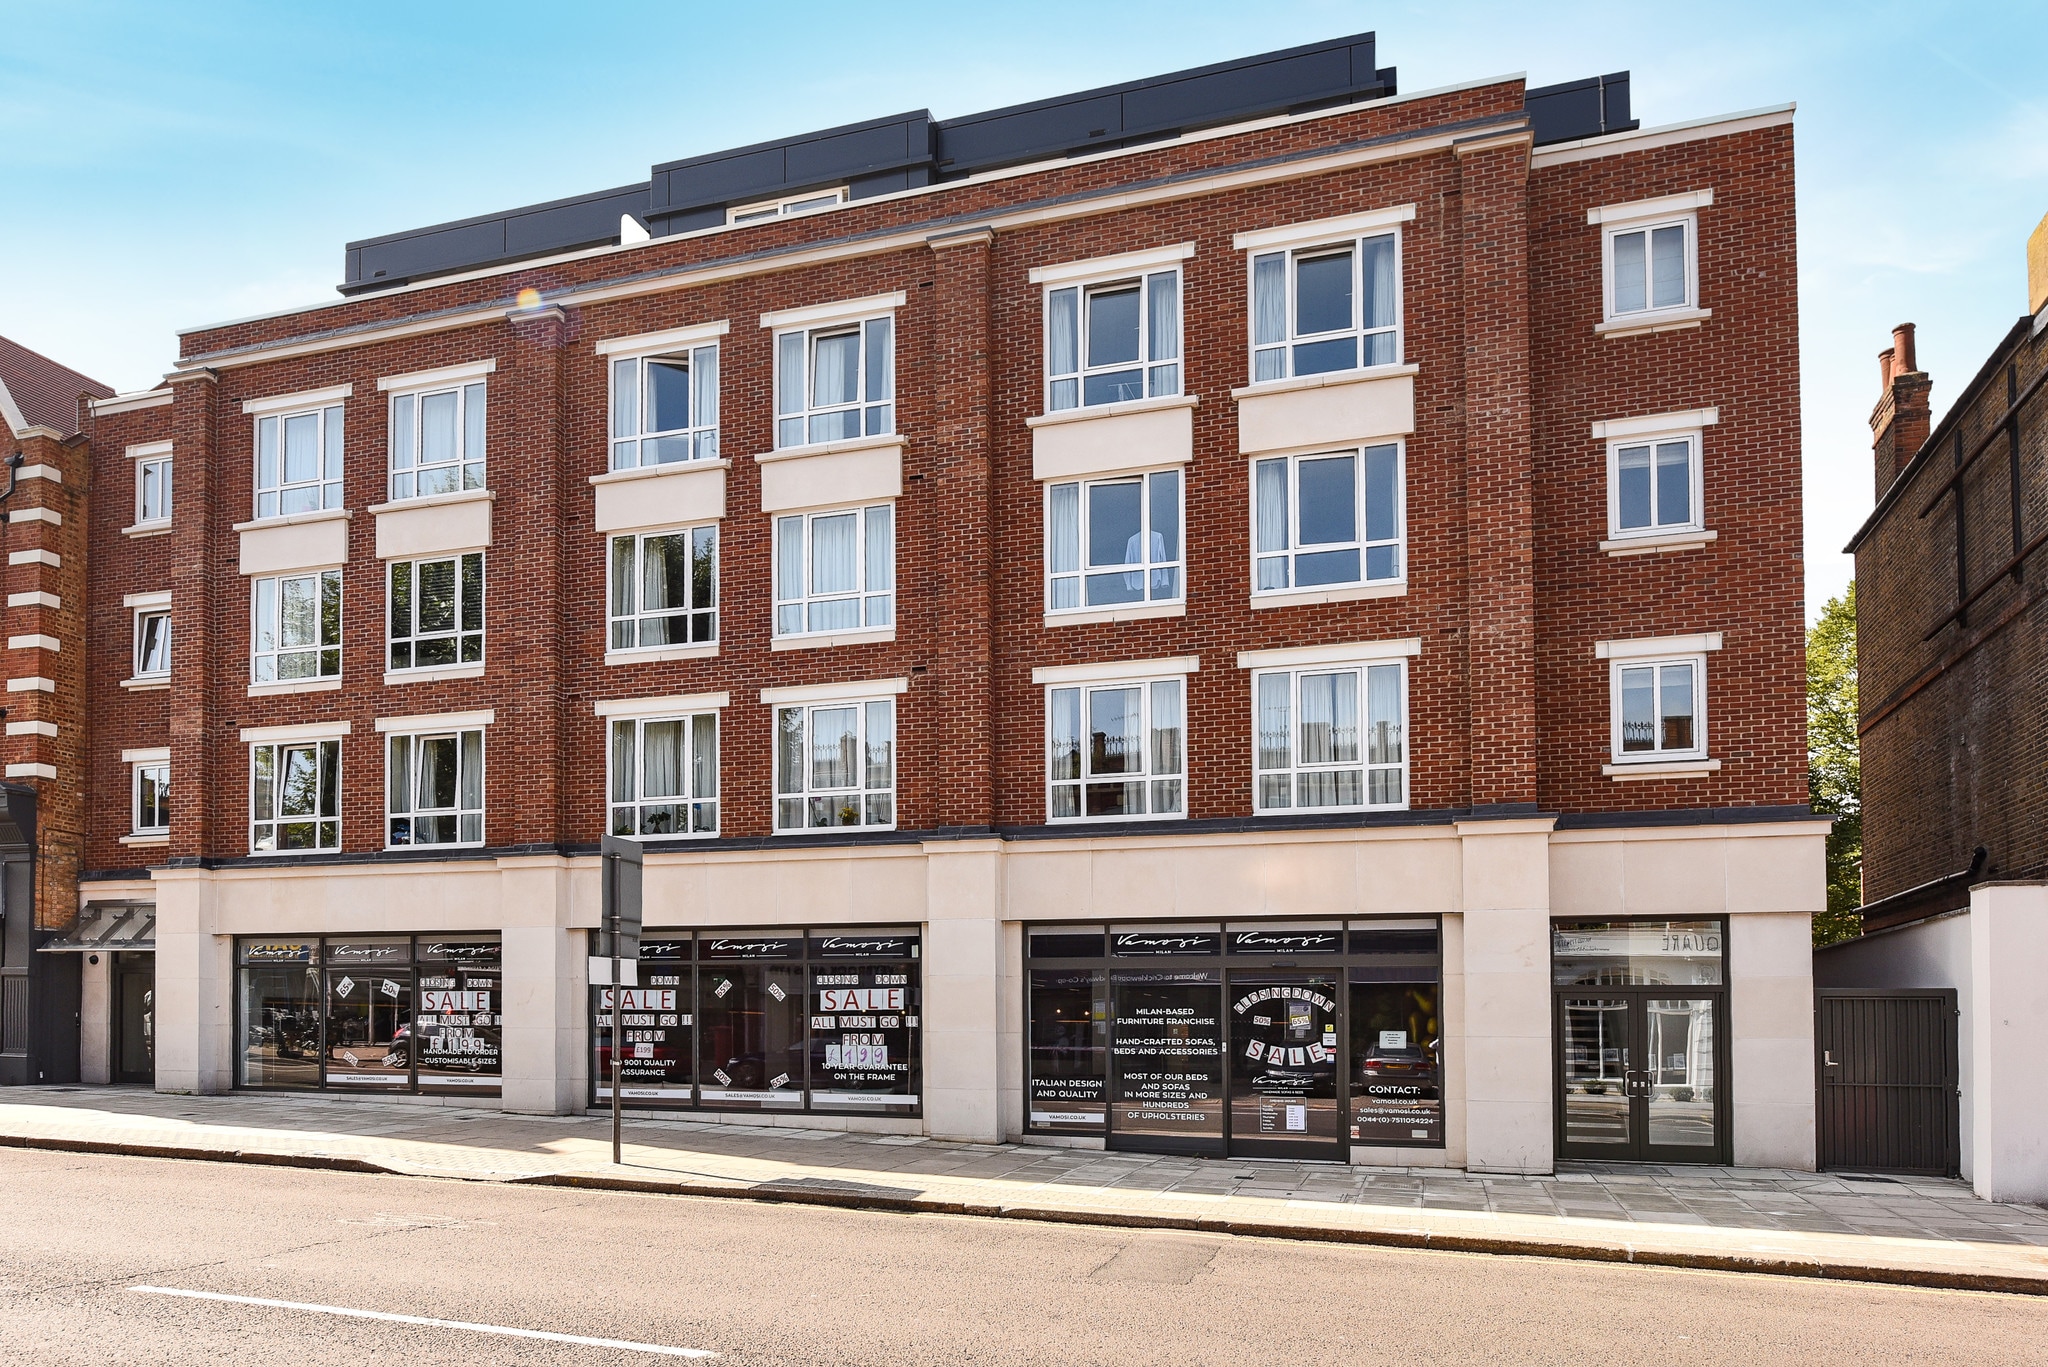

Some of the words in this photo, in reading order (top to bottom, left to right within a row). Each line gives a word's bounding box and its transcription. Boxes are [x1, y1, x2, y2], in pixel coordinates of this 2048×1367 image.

[467, 978, 493, 988] DOWN
[651, 976, 679, 985] DOWN
[817, 975, 859, 985] CLOSING
[875, 975, 907, 984] DOWN
[425, 992, 487, 1010] SALE
[605, 990, 672, 1009] SALE
[825, 989, 899, 1010] SALE
[418, 1015, 437, 1026] ALL
[440, 1015, 469, 1025] MUST
[476, 1015, 491, 1025] GO
[622, 1015, 655, 1025] MUST
[660, 1015, 677, 1026] GO
[812, 1017, 834, 1028] ALL
[840, 1016, 875, 1028] MUST
[880, 1016, 899, 1028] GO
[1254, 1016, 1270, 1025] 50%
[440, 1028, 475, 1038] FROM
[627, 1031, 665, 1041] FROM
[843, 1034, 884, 1045] FROM
[1116, 1038, 1183, 1046] HAND-CRAFTED
[1185, 1038, 1216, 1046] SOFAS,
[1159, 1048, 1218, 1056] ACCESSORIES
[1249, 1042, 1324, 1064] SALE
[643, 1059, 676, 1067] QUALITY
[821, 1062, 855, 1070] 10-YEAR
[857, 1063, 908, 1071] GUARANTEE
[620, 1068, 666, 1076] ASSURANCE
[866, 1073, 896, 1081] FRAME
[1164, 1073, 1184, 1081] OUR
[1185, 1073, 1209, 1081] BEDS
[1031, 1078, 1067, 1087] ITALIAN
[1068, 1080, 1103, 1088] DESIGN
[1162, 1083, 1190, 1091] SOFAS
[1058, 1090, 1098, 1098] QUALITY
[1368, 1085, 1421, 1095] CONTACT:
[1162, 1091, 1187, 1099] SIZES
[1188, 1092, 1208, 1100] AND
[1142, 1101, 1190, 1109] HUNDREDS
[1359, 1107, 1431, 1115] sales@vamosi.co.uk
[1127, 1111, 1140, 1119] OF
[1141, 1112, 1205, 1121] UPHOLSTERIES
[1378, 1116, 1390, 1124] (0)
